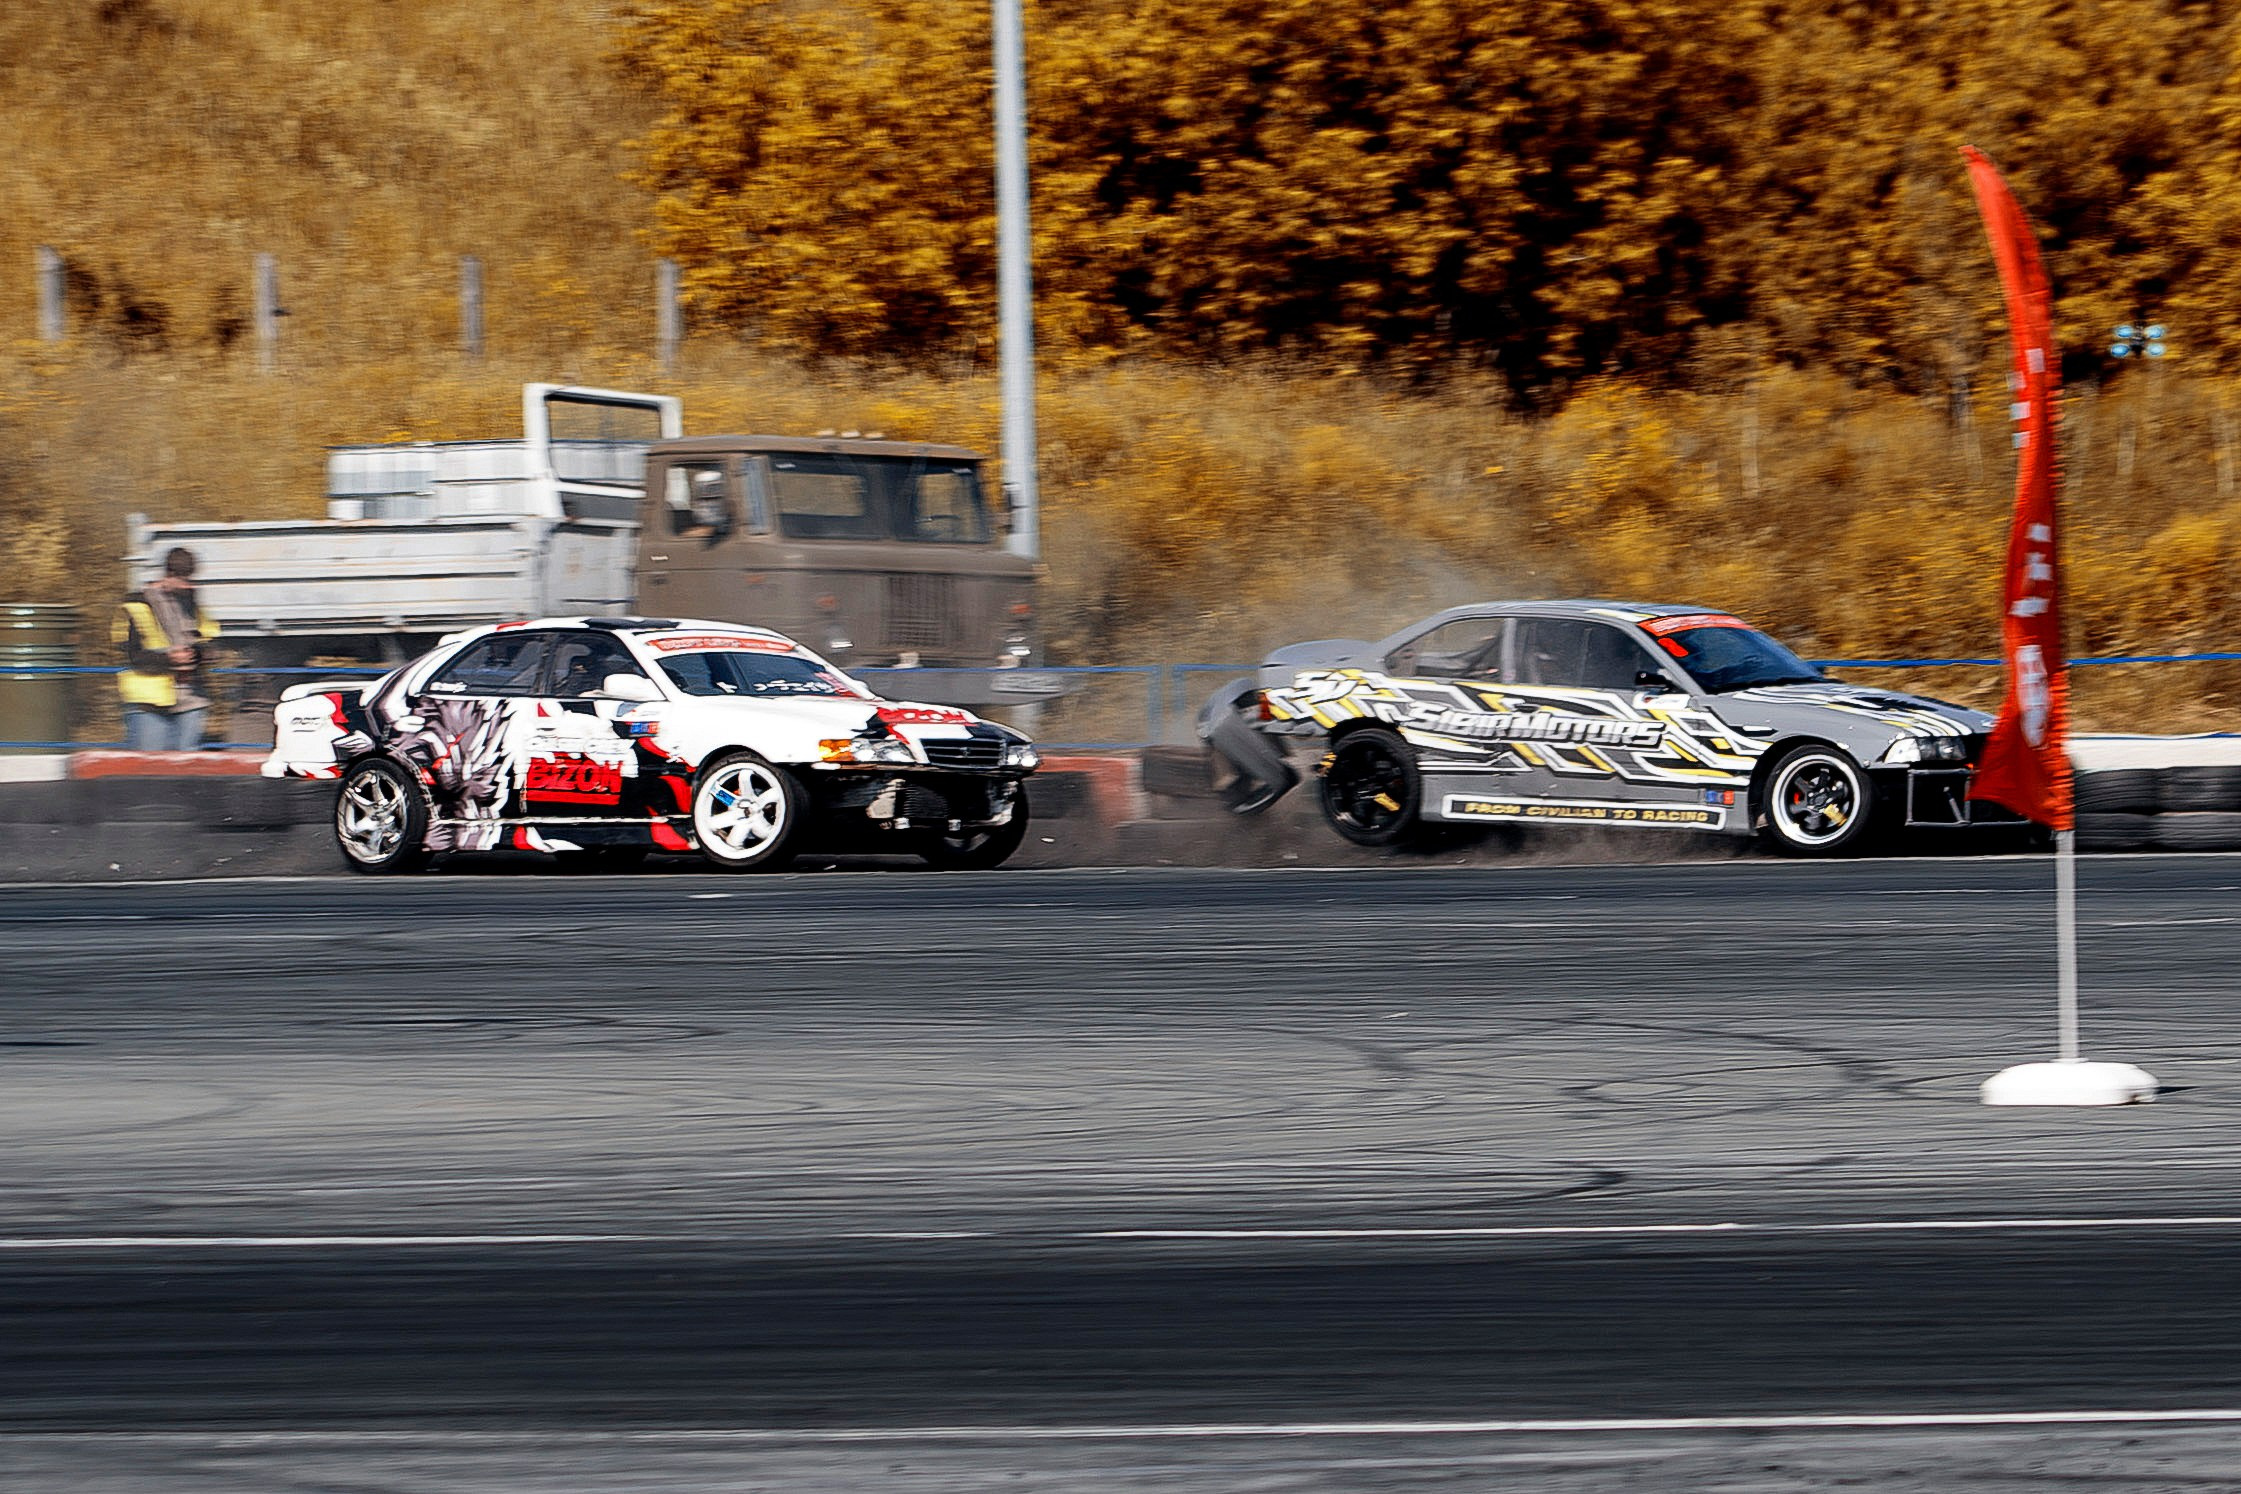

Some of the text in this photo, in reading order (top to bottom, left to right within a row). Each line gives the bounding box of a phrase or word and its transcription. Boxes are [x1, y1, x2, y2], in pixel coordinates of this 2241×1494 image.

[1465, 802, 1708, 822] FROM CIVILIAN TO RACING
